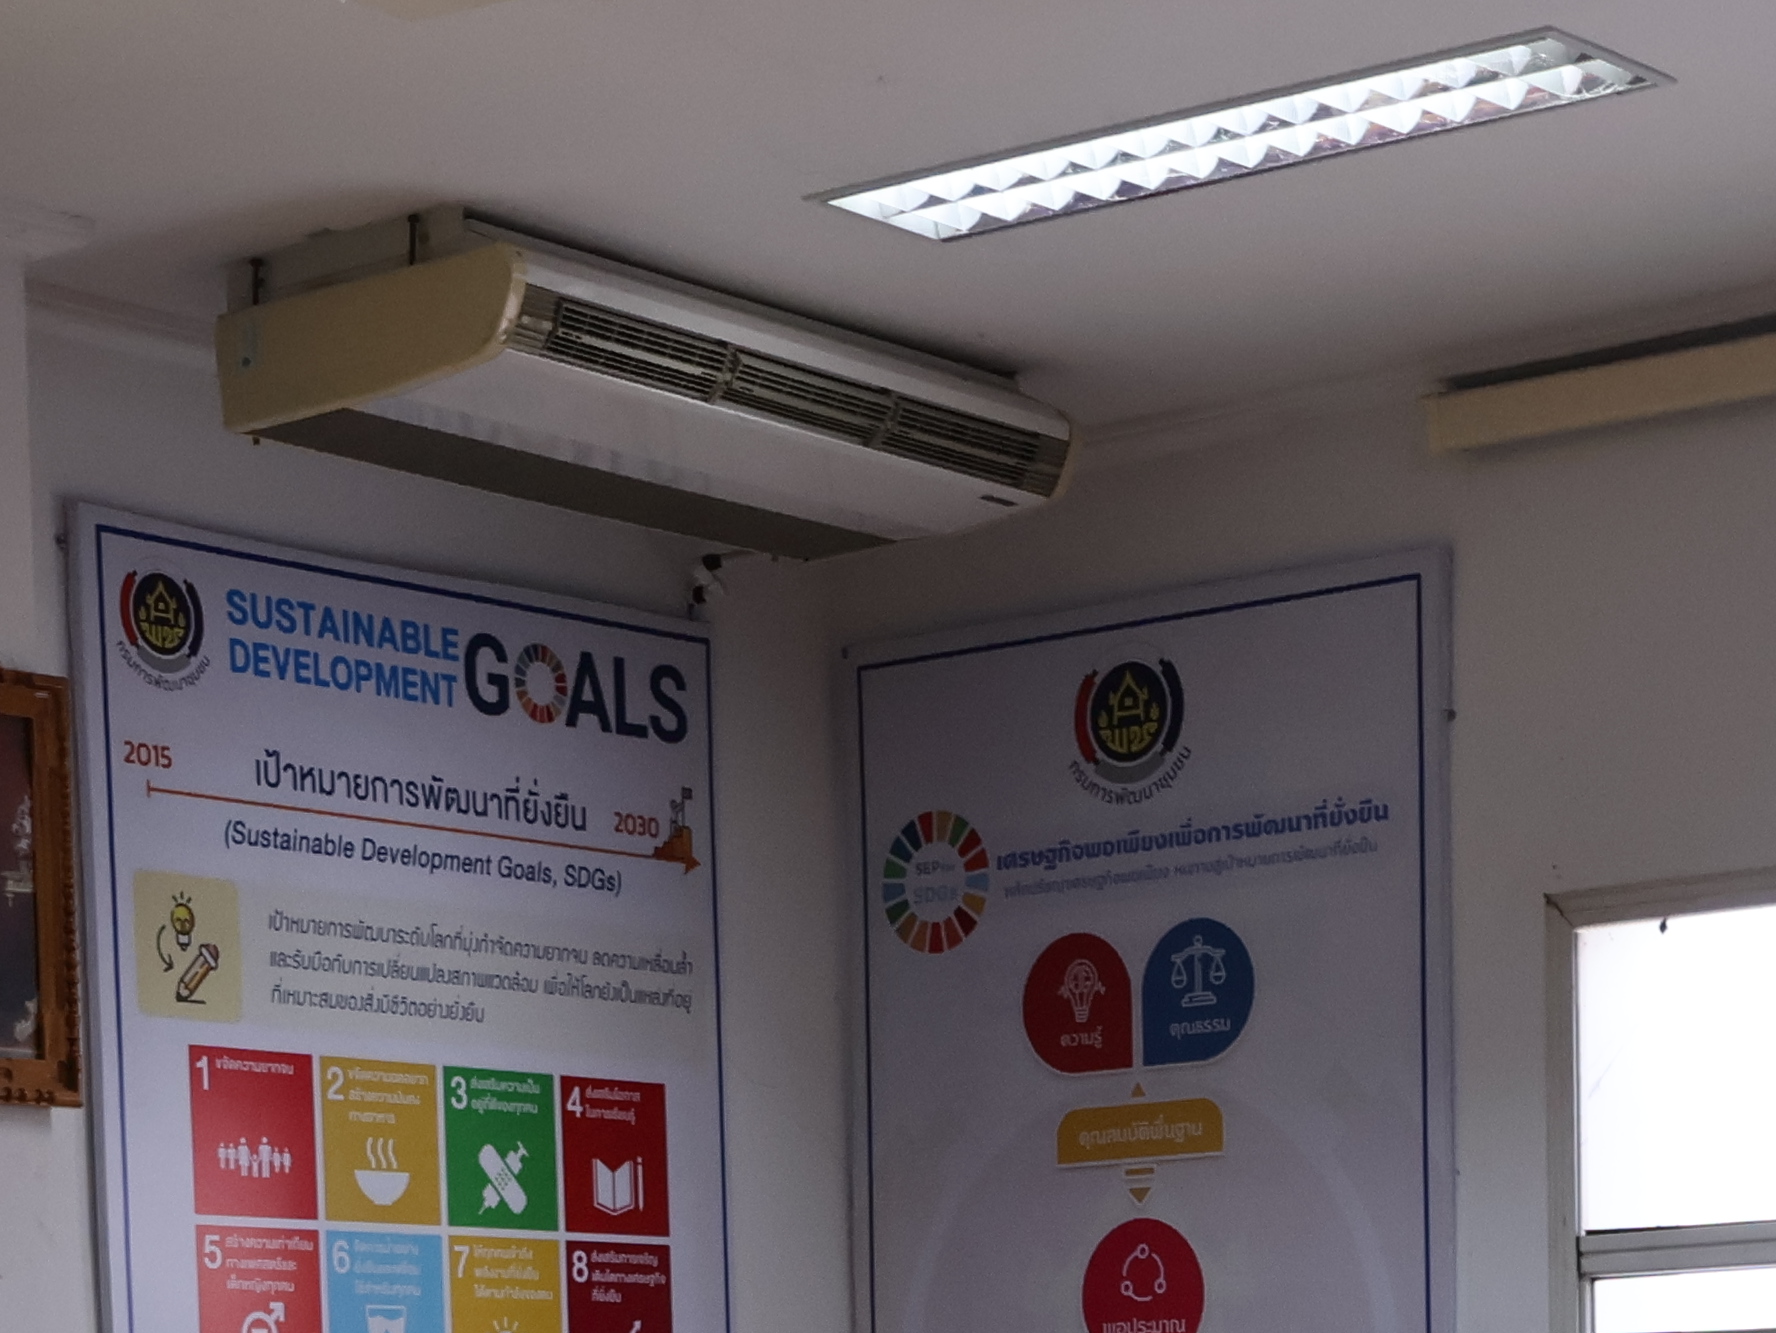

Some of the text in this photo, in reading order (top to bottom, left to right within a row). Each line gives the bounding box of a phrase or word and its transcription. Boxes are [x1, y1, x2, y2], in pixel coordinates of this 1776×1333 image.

[226, 588, 461, 663] SUSTAINABLE
[228, 632, 690, 745] DEVELOPMENT GOALS
[123, 739, 174, 770] 2015
[253, 748, 589, 833] เป้าหมายการพัฒนาที่ยั่งยืน
[613, 812, 660, 840] 2030
[996, 798, 1390, 872] เศรษฐกิจพอเพียงเพื่อการพัฒนาที่ยั่งยืน
[223, 820, 623, 897] (Sustainable Development Goals, SDGs)
[195, 1055, 210, 1091] 1
[326, 1065, 345, 1101] 2
[450, 1075, 469, 1110] 3
[566, 1085, 584, 1119] 4
[204, 1234, 223, 1270] 5
[332, 1239, 351, 1274] 6
[454, 1244, 471, 1279] 7
[571, 1249, 590, 1284] 8
